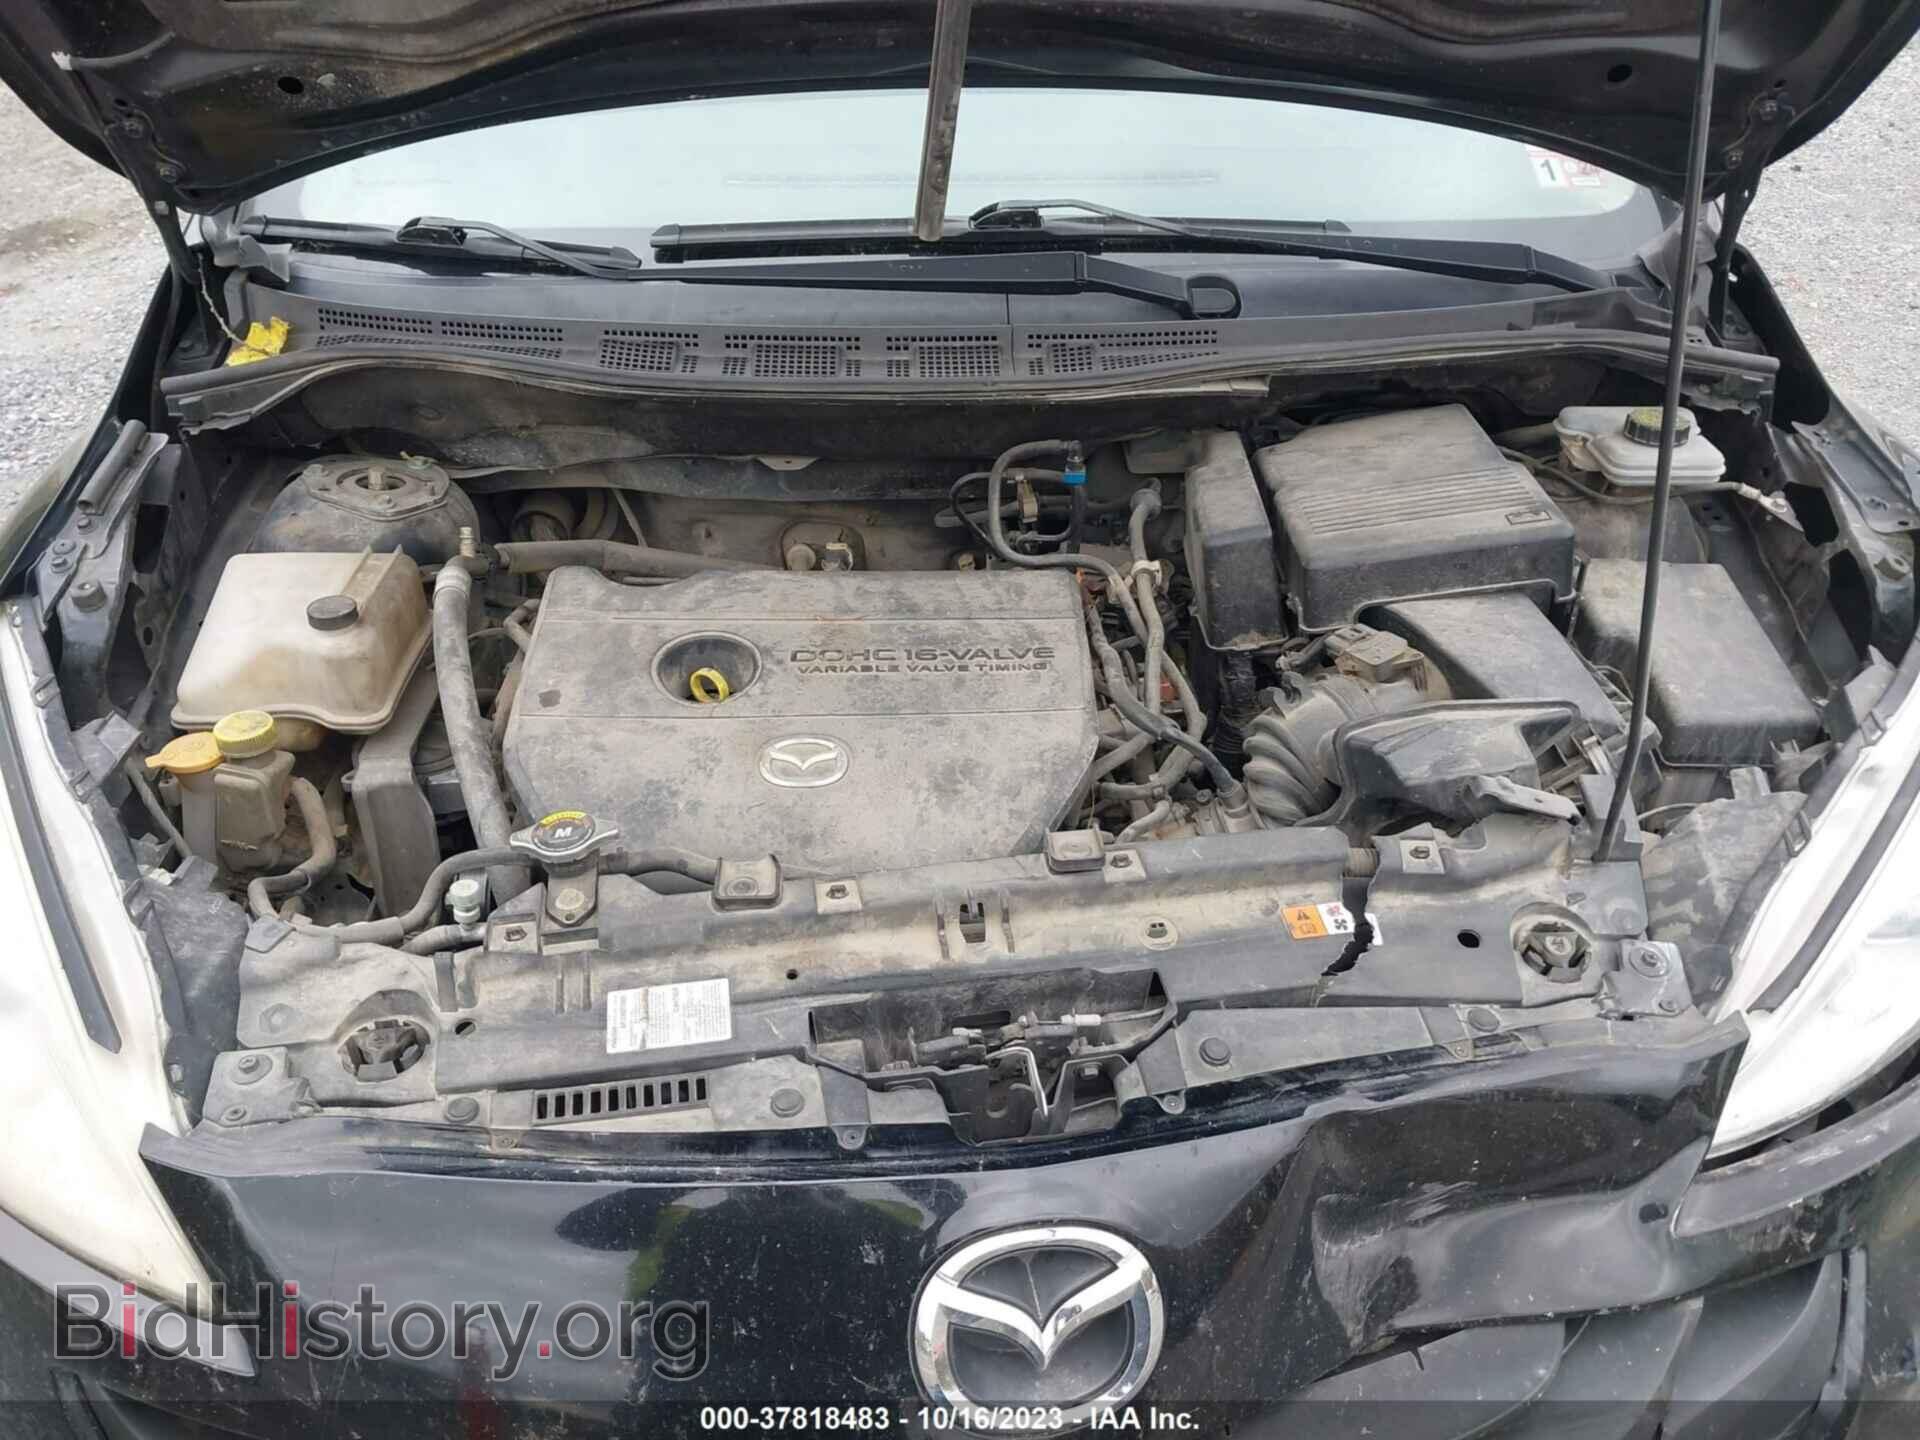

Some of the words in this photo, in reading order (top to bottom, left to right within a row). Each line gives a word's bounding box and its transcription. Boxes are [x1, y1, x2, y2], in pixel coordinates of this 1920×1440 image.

[789, 649, 897, 663] DOHC
[904, 646, 1055, 662] 16-VALVE
[797, 663, 900, 675] VARIABLE
[905, 663, 969, 673] VALVE
[975, 661, 1048, 672] TIMING
